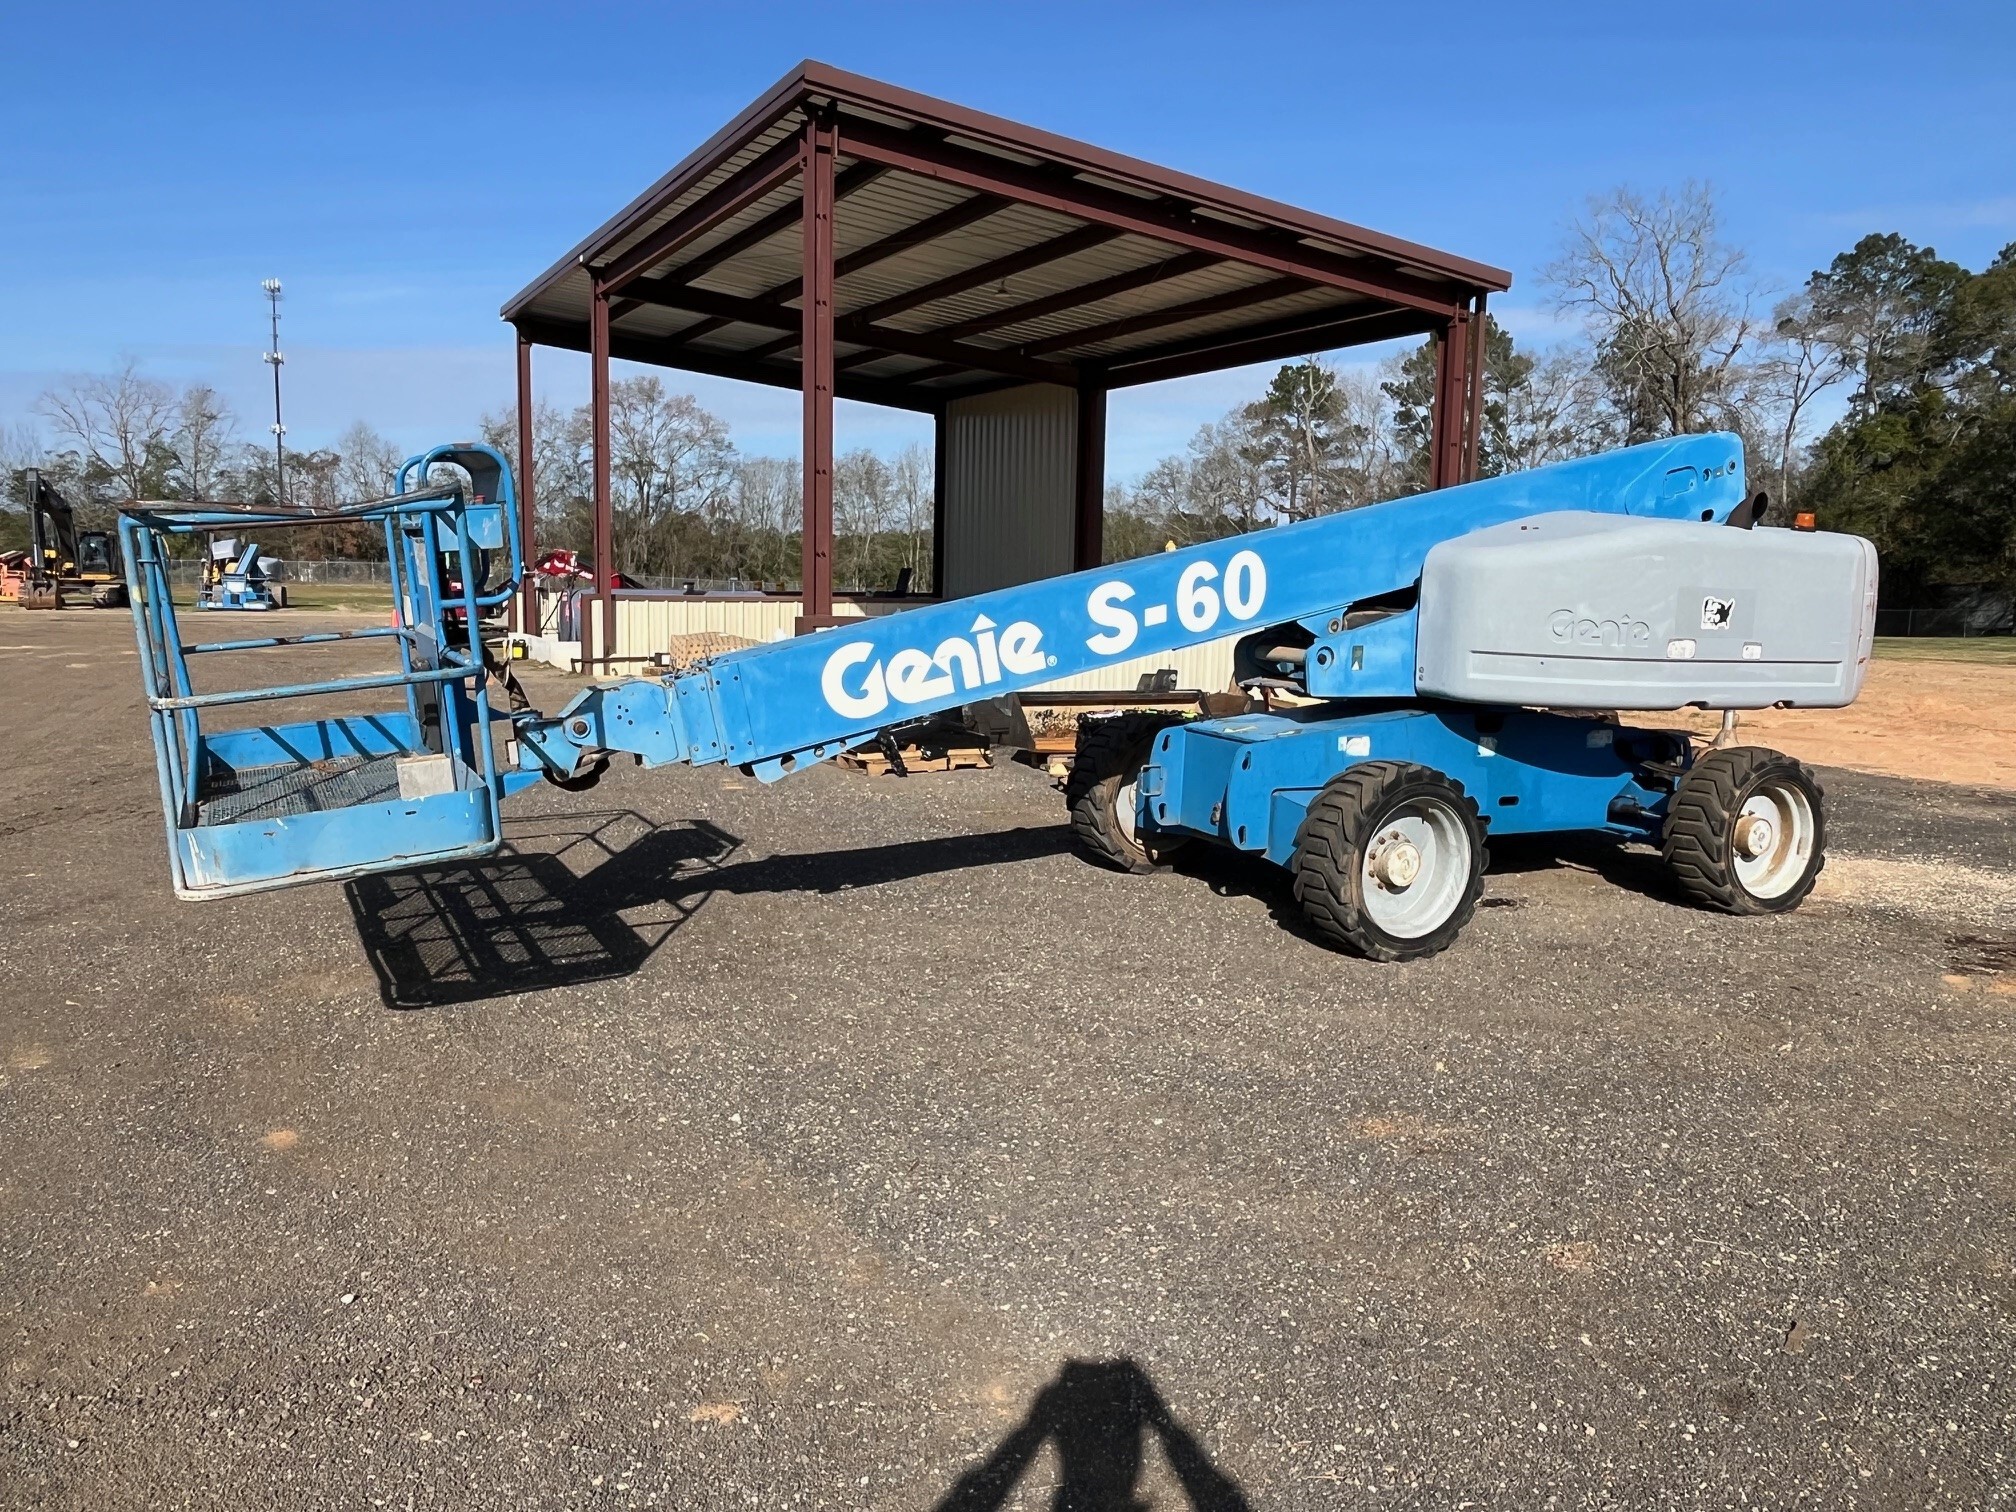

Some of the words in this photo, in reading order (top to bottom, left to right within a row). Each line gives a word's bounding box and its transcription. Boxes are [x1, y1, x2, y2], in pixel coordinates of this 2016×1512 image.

[821, 614, 1046, 719] Genie
[1086, 550, 1267, 655] S-60
[1547, 608, 1650, 647] Genie
